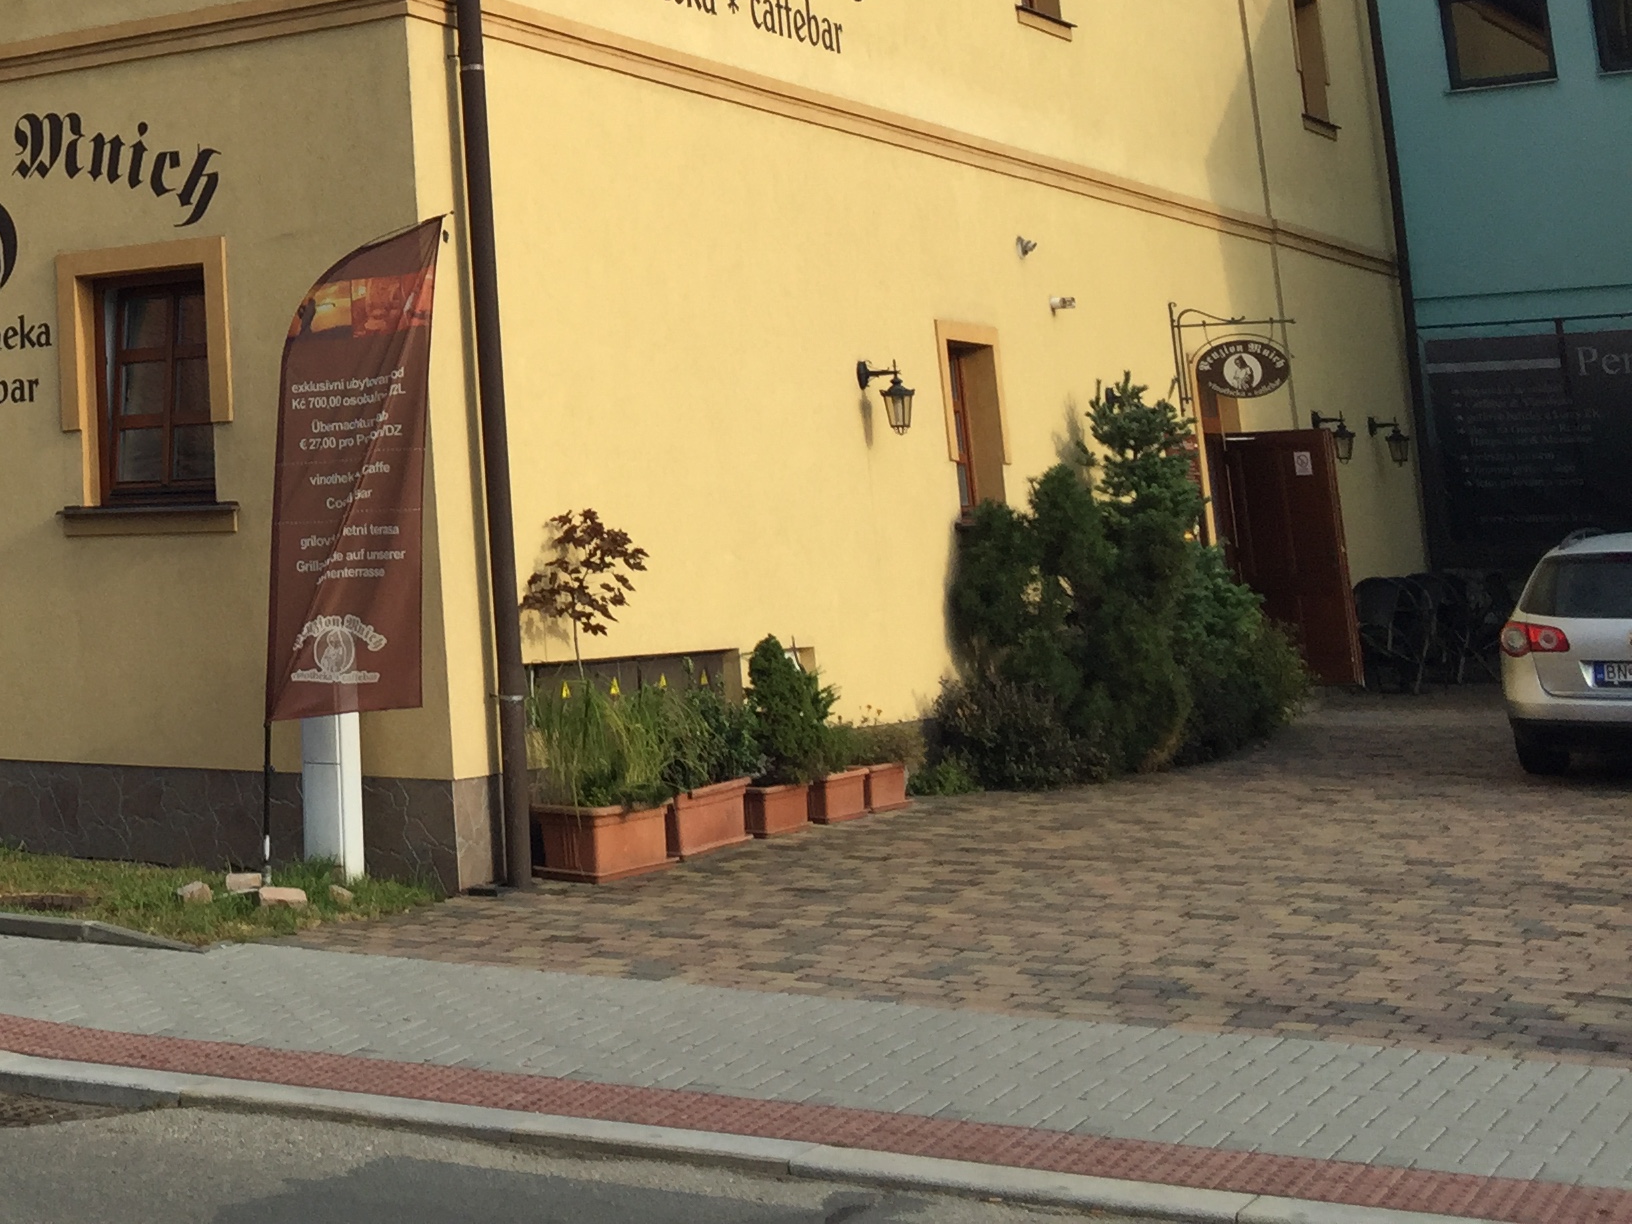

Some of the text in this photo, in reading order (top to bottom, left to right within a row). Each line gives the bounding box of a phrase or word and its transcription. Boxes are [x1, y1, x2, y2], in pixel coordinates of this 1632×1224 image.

[12, 112, 223, 228] Mnich
[308, 395, 342, 409] 700,00
[338, 436, 354, 450] pro
[345, 548, 366, 562] auf
